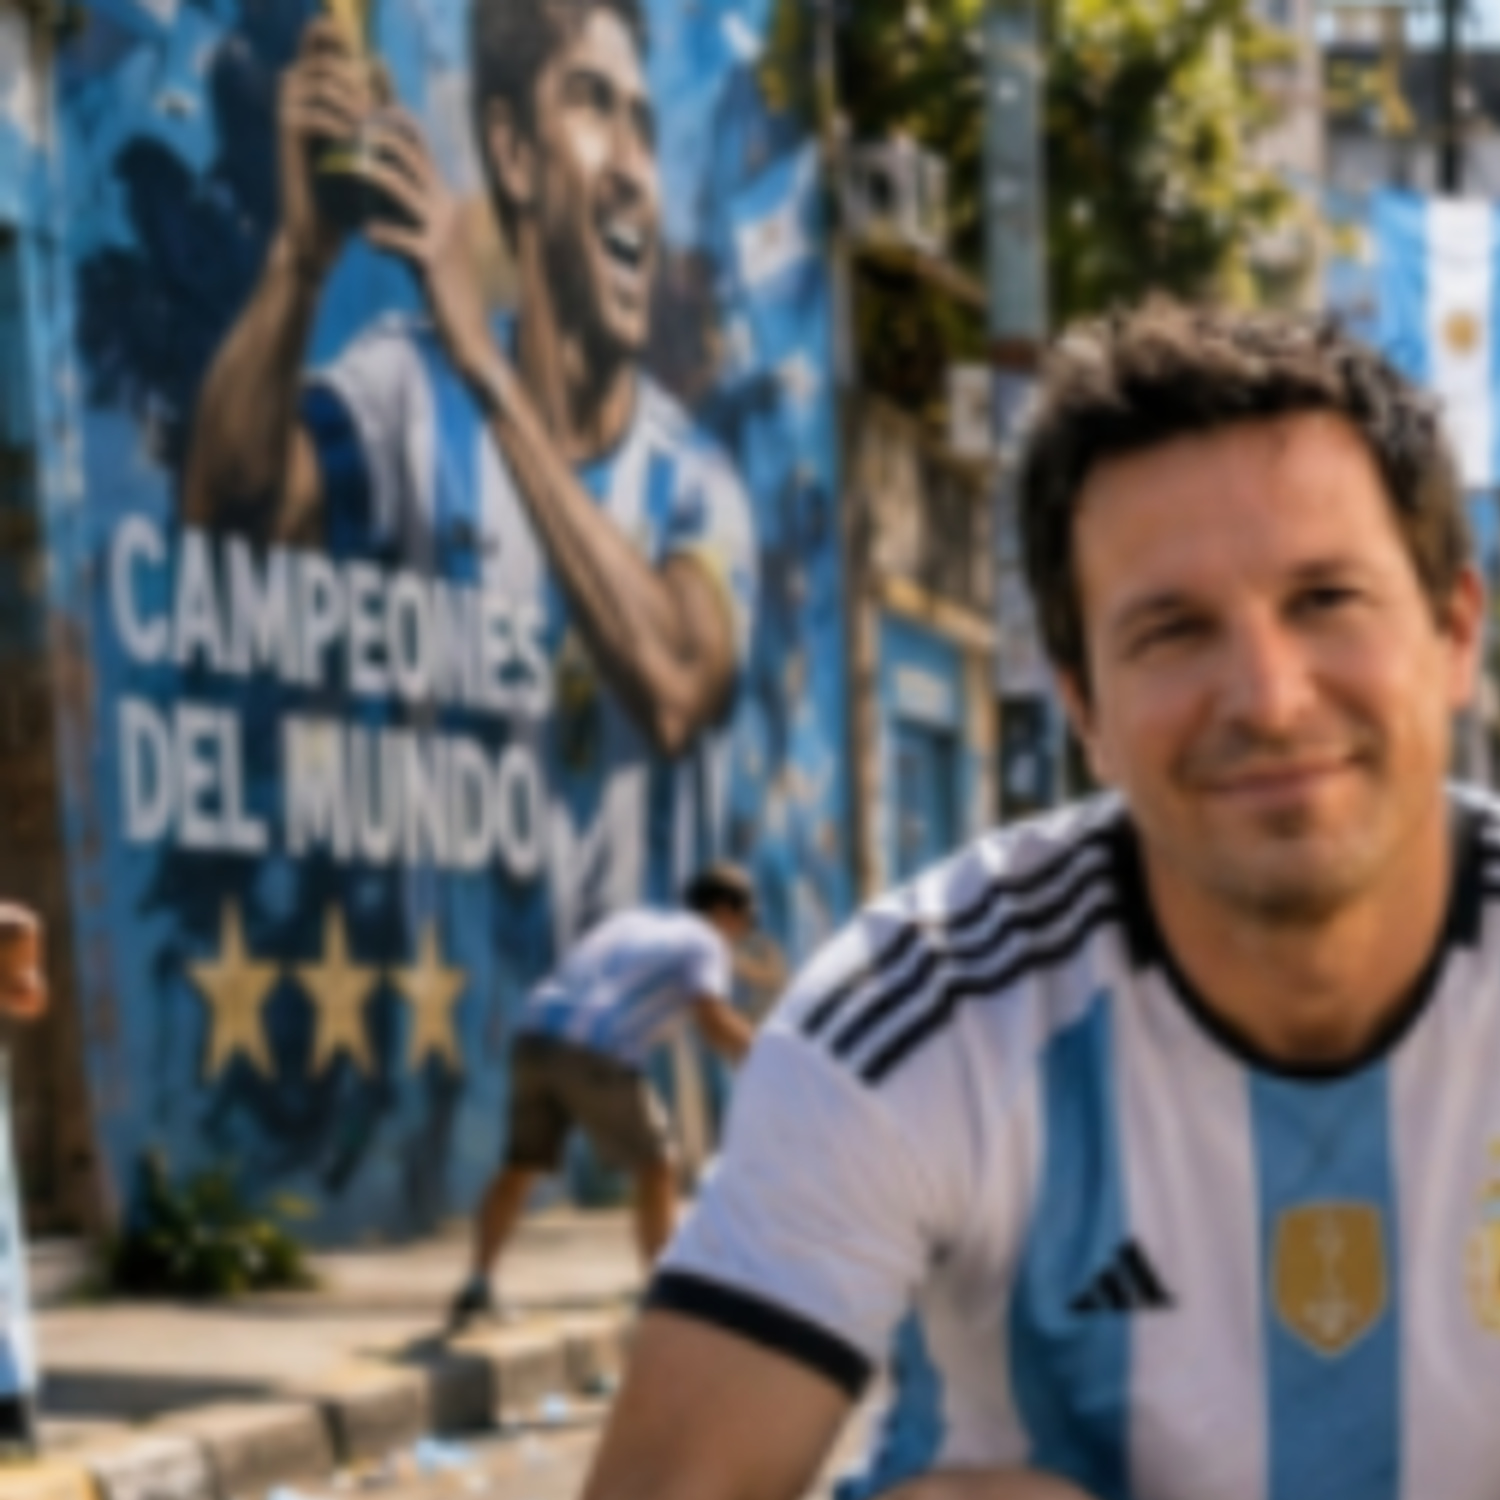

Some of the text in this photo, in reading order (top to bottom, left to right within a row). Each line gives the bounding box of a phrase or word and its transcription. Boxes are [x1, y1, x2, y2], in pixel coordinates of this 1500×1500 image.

[111, 512, 554, 718] CAMPEONES
[118, 696, 540, 878] DEL MUNDO
